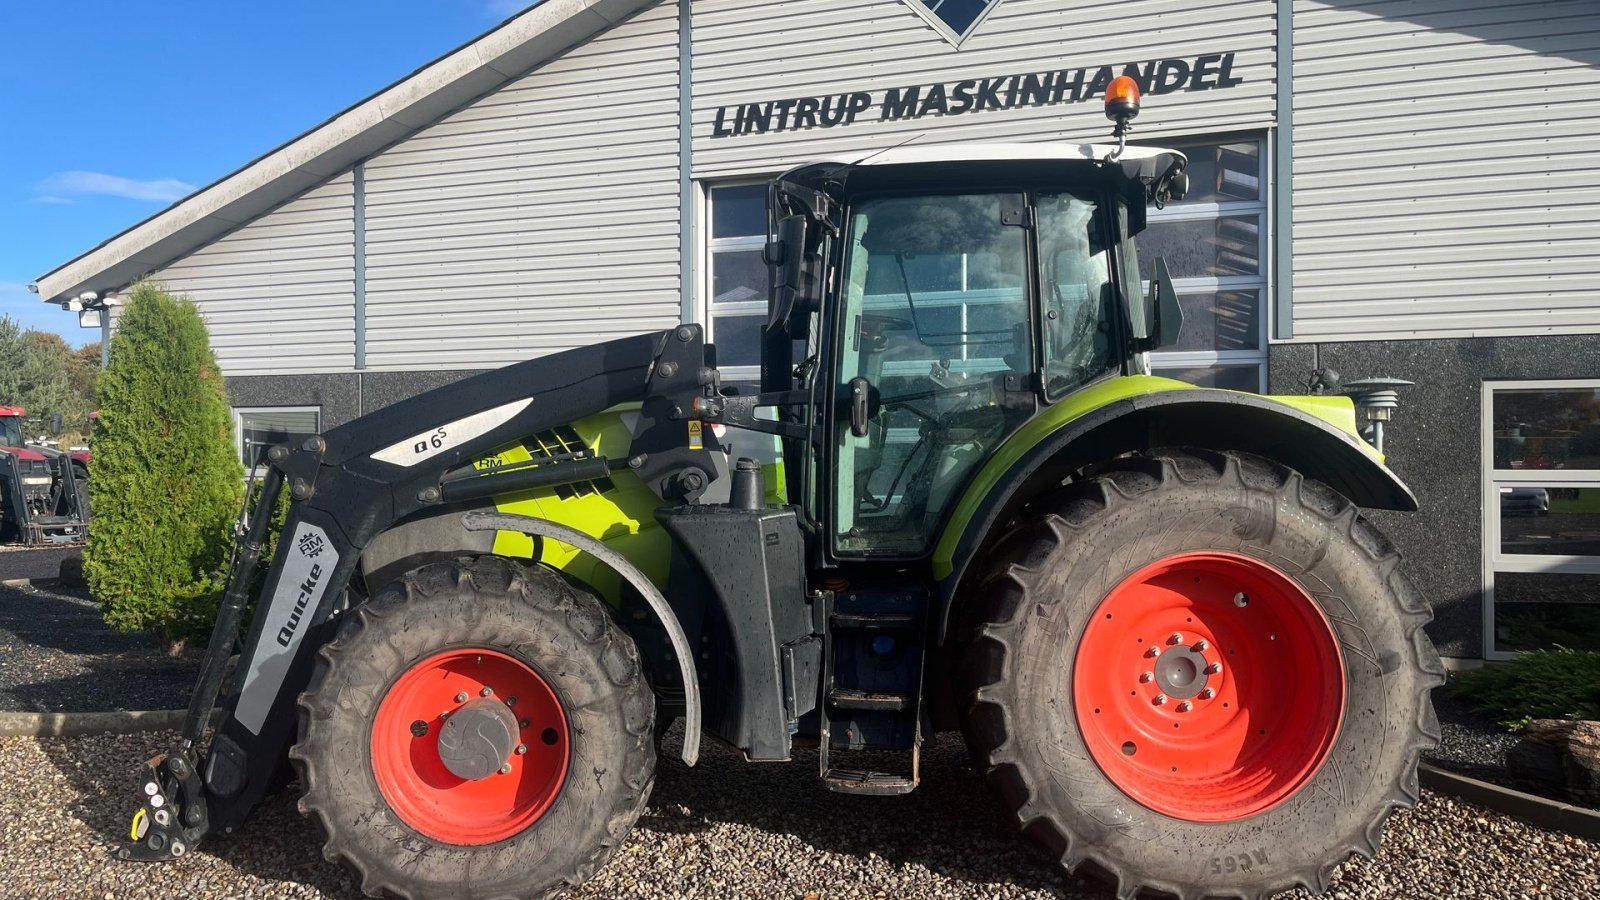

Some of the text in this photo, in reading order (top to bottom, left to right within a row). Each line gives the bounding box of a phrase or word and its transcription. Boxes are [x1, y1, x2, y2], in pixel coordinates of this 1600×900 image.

[713, 53, 1243, 136] LINTRUP MASKINHANDEL
[276, 563, 322, 648] Quicke
